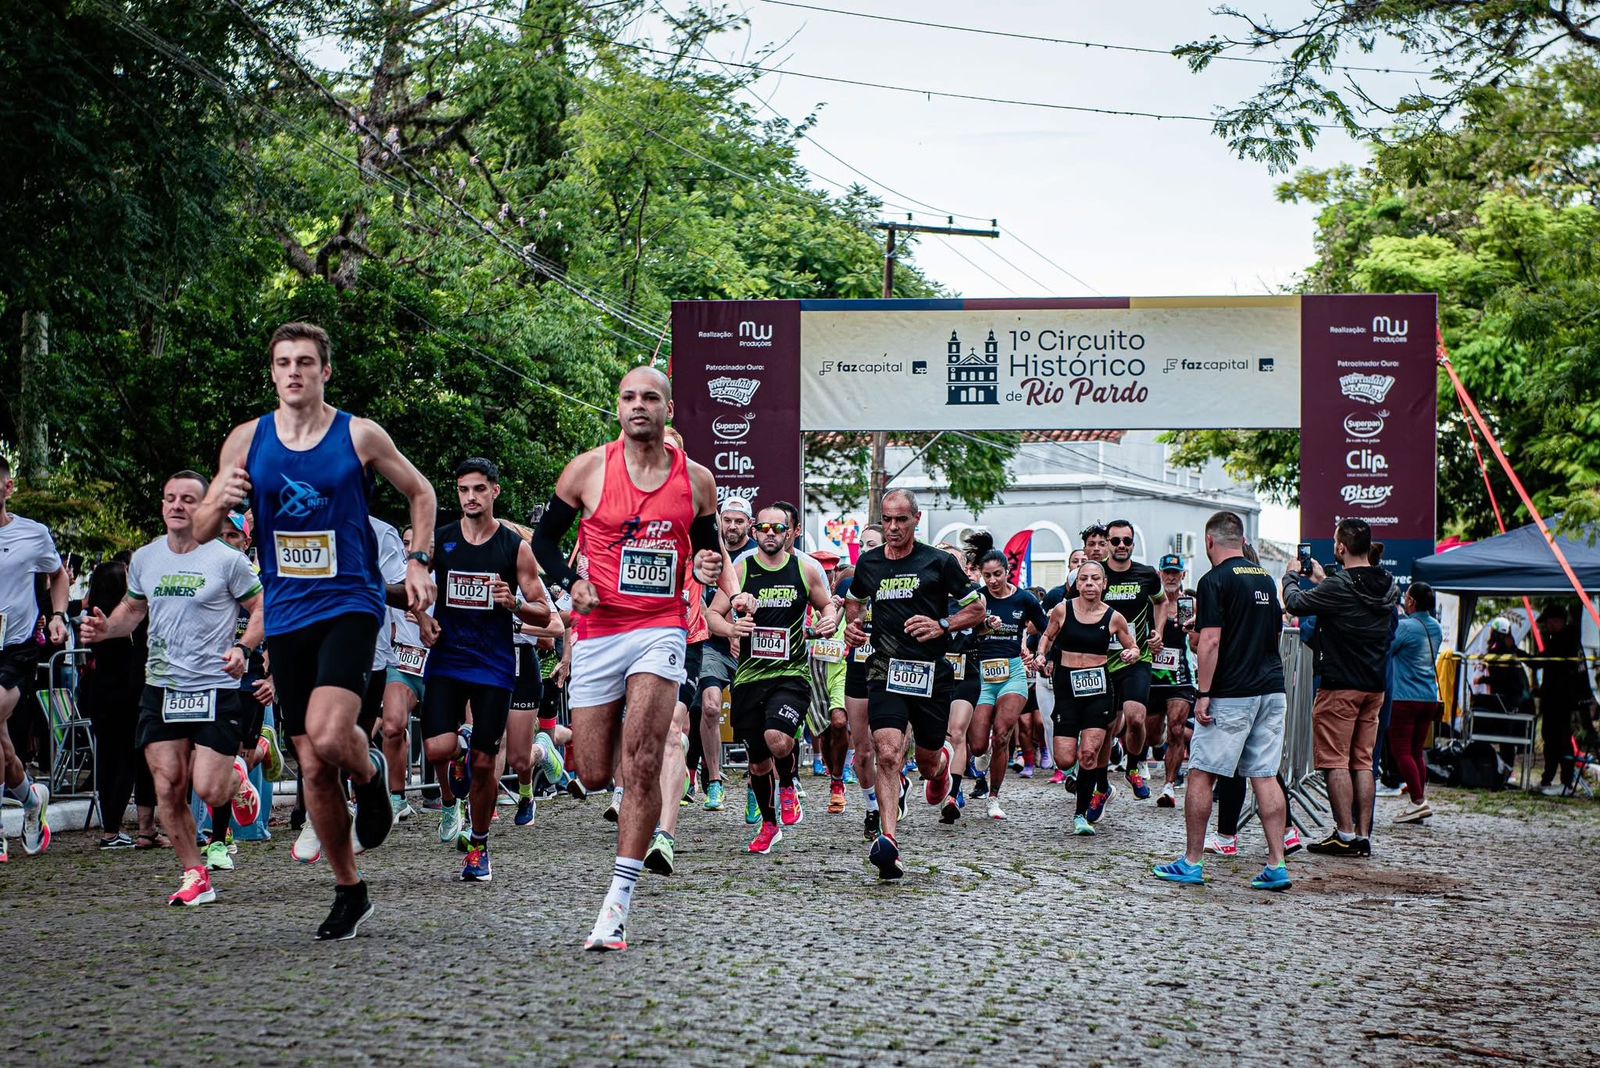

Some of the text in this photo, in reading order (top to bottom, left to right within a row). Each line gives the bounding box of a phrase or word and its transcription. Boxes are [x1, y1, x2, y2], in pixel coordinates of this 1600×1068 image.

[698, 331, 733, 339] Realização:
[1329, 327, 1367, 335] Realização:
[1038, 330, 1145, 351] Circuito
[1009, 351, 1146, 377] Histórico
[1005, 377, 1149, 405] de Rio Pardo
[715, 422, 747, 431] Superpan
[1347, 420, 1381, 428] Superpan
[714, 451, 755, 474] Clip.
[1346, 449, 1388, 473] Clip.
[716, 485, 759, 500] Bistex
[1340, 484, 1393, 502] Bistex
[647, 520, 673, 538] RP
[283, 548, 321, 563] 3007
[627, 565, 667, 581] 5005
[161, 575, 195, 587] SUPER
[880, 578, 912, 591] SUPER
[153, 587, 197, 597] RUNNERS
[454, 585, 483, 597] 1002
[759, 588, 790, 600] SUPER
[875, 588, 914, 602] RUNNERS
[1109, 584, 1136, 594] SUPER
[756, 598, 792, 608] RUNNERS
[1104, 593, 1136, 601] RUNNERS
[757, 638, 781, 649] 1004
[818, 645, 838, 655] 3123
[399, 652, 420, 665] 1000
[894, 671, 924, 684] 5007
[985, 667, 1006, 676] 3001
[1076, 676, 1099, 688] 5000
[170, 698, 204, 709] 5004
[778, 708, 799, 726] LIFE
